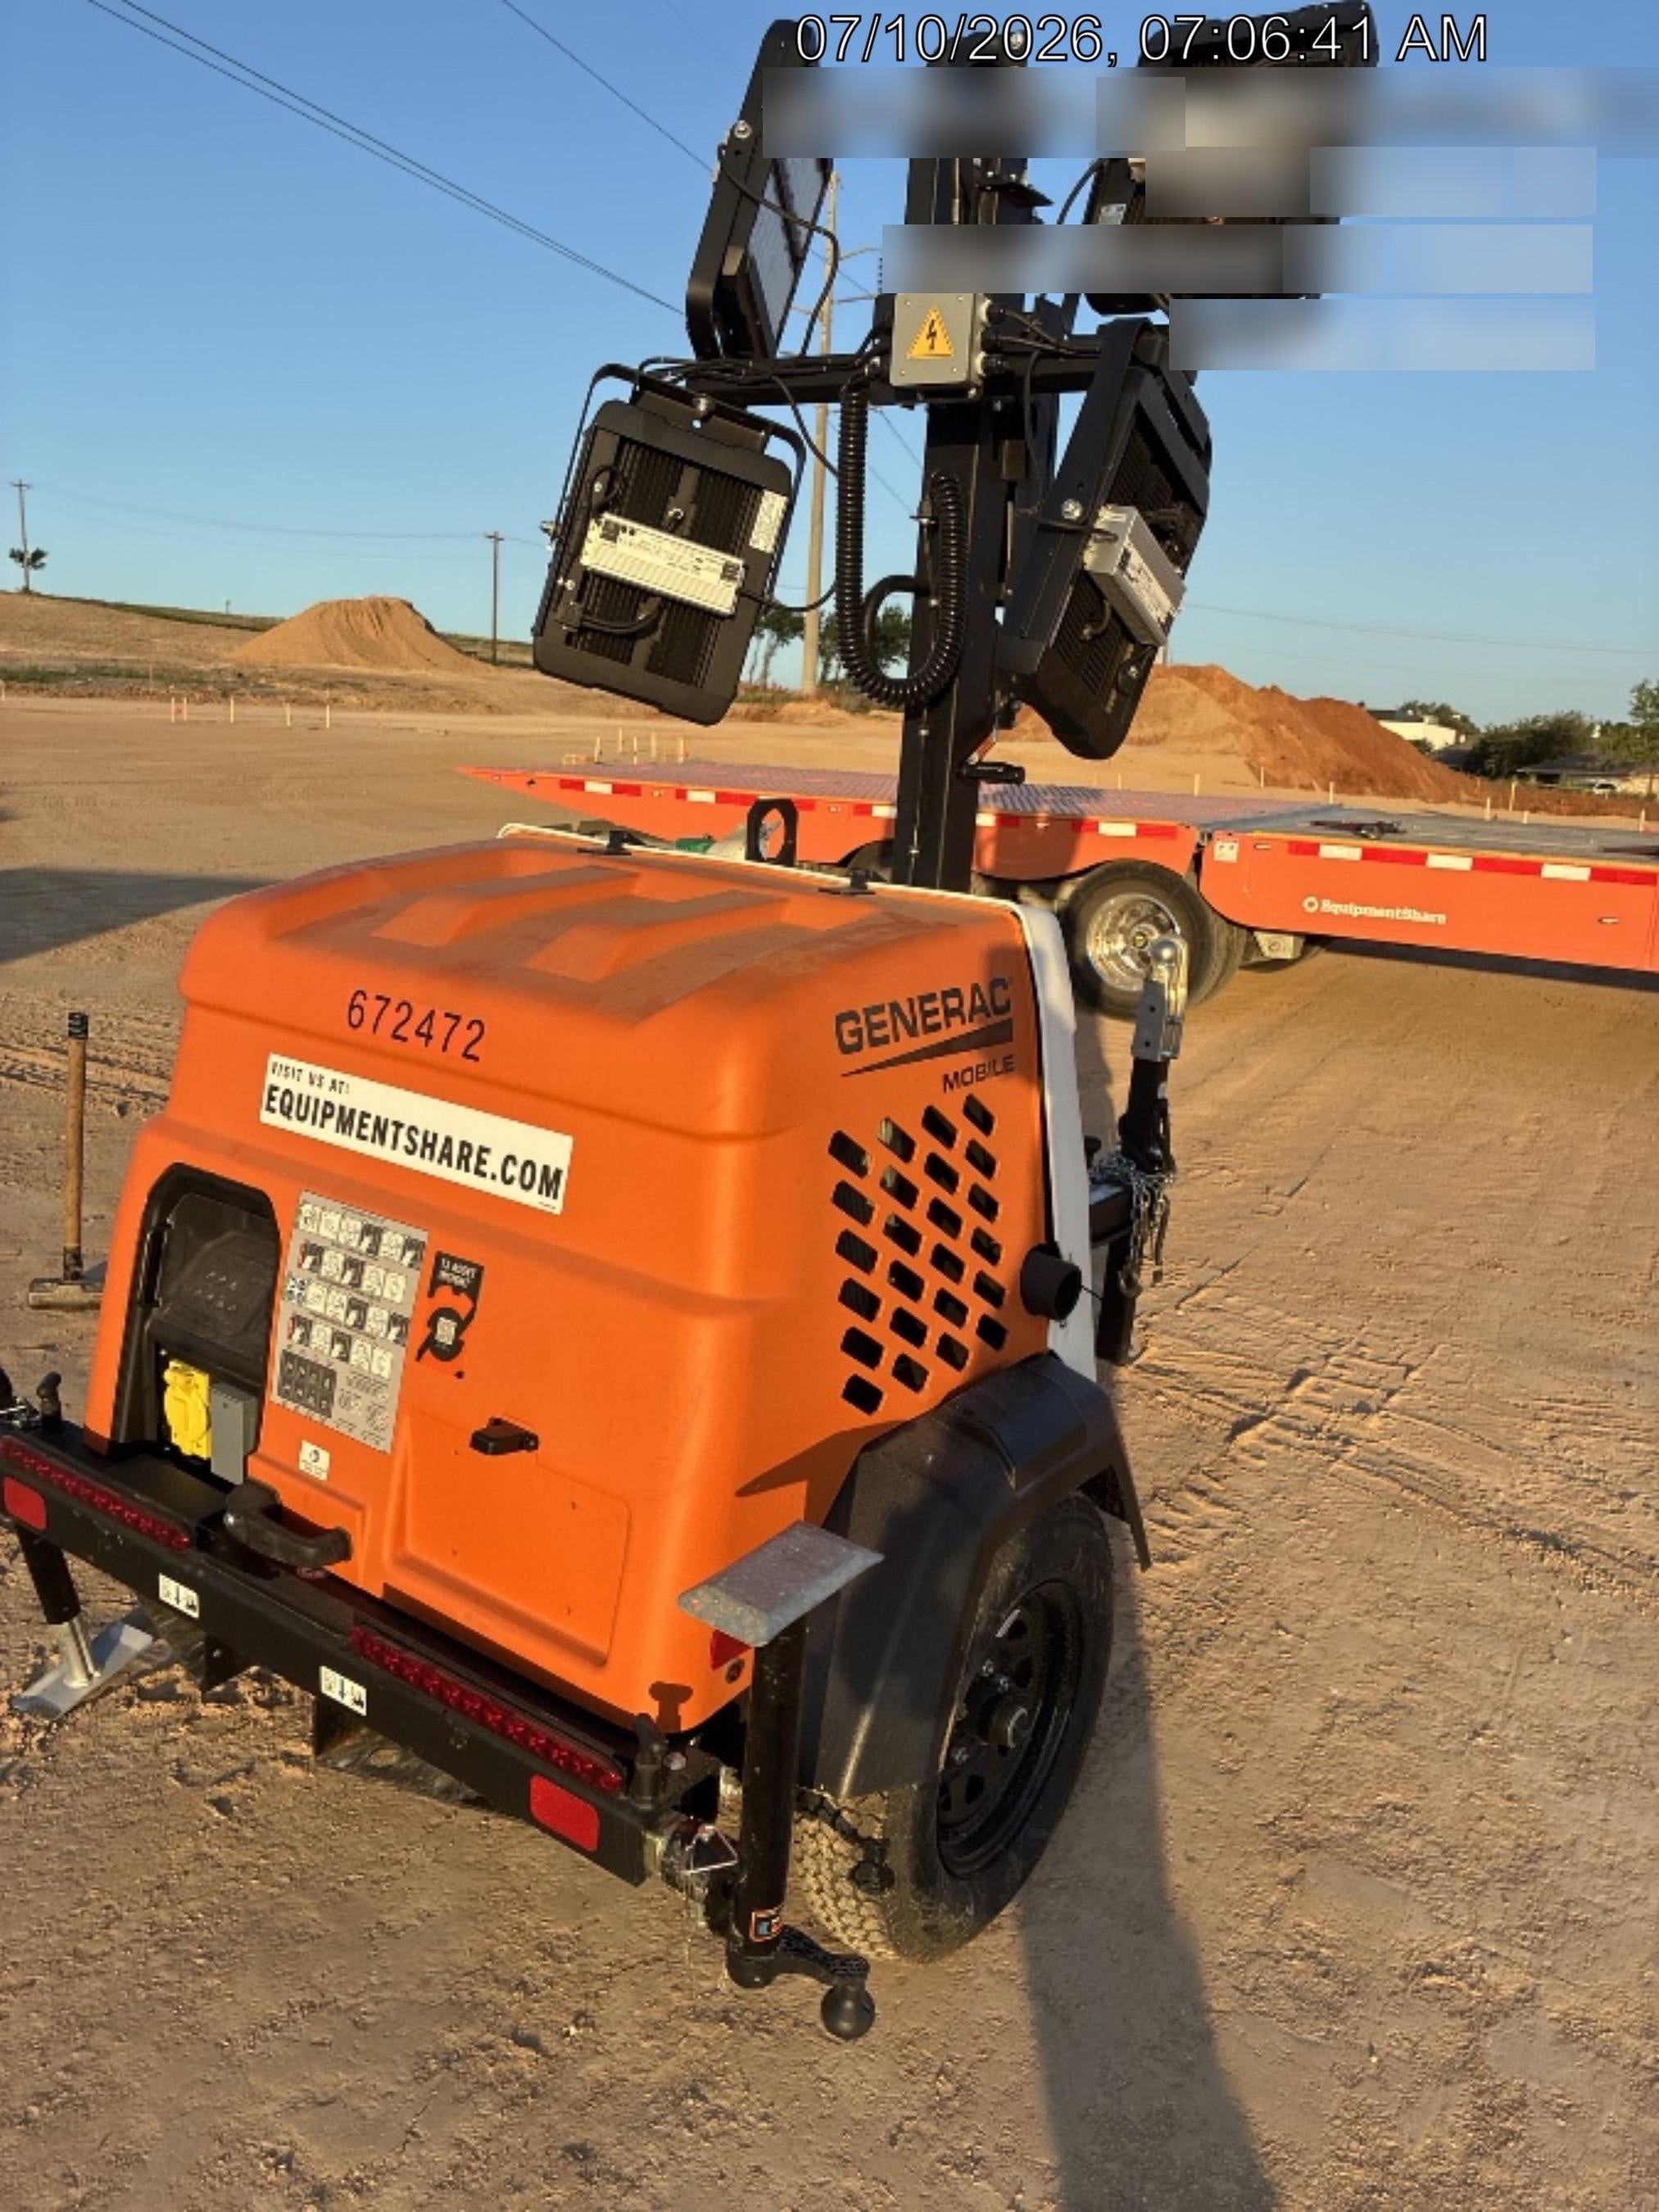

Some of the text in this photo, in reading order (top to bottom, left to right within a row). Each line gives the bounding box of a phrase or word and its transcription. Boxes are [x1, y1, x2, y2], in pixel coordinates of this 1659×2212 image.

[1320, 899, 1447, 925] EquipmentShare
[347, 990, 486, 1062] 672472
[834, 977, 1011, 1054] GENERAC
[271, 1061, 350, 1095] VISIT US AT:
[943, 1054, 1015, 1093] MOBILE
[265, 1084, 564, 1200] EQUIPMENTSHARE.COM
